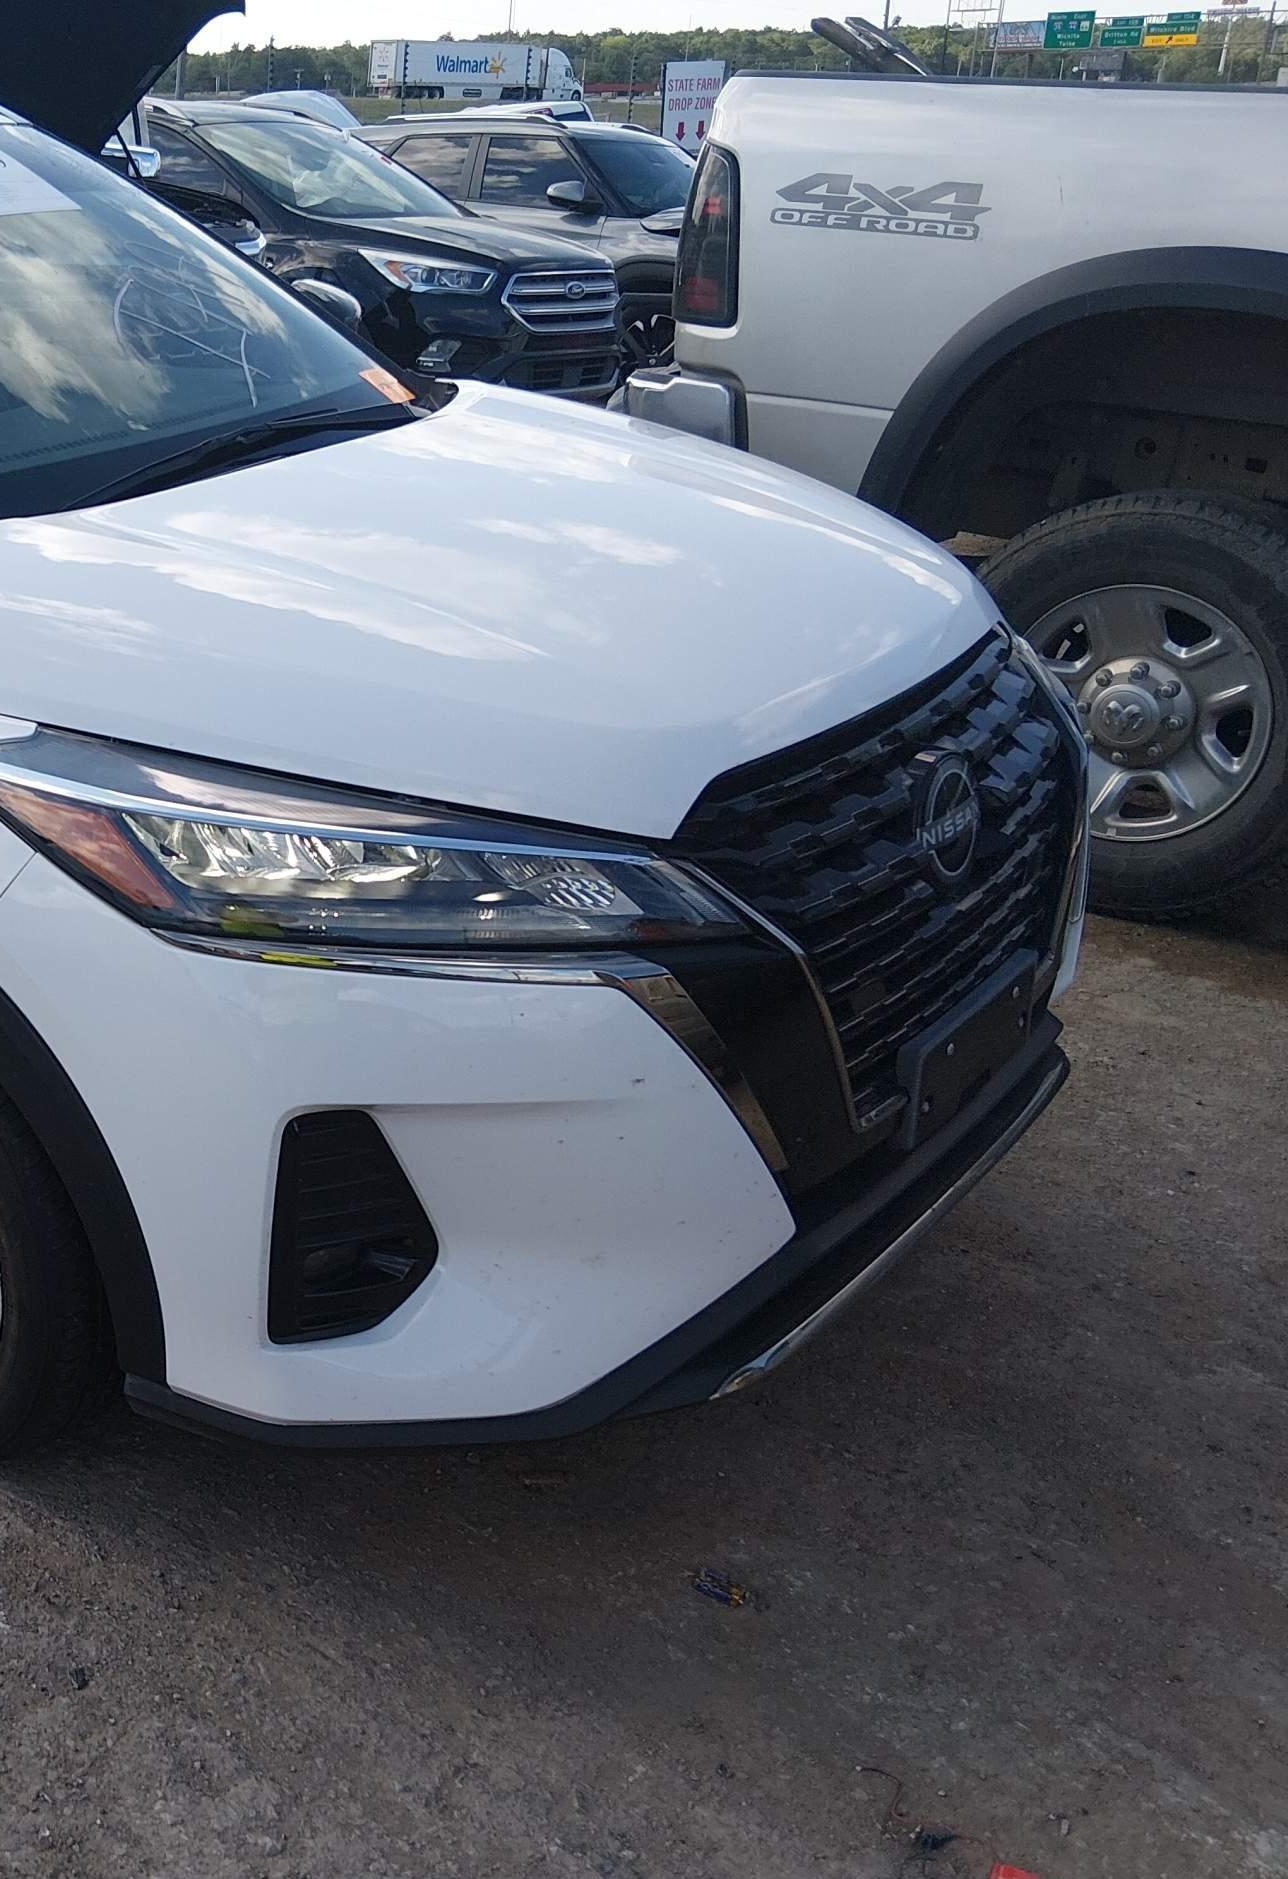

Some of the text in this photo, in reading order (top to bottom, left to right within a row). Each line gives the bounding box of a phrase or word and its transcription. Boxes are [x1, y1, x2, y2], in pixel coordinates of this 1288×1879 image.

[436, 54, 489, 73] Walmart
[668, 77, 721, 92] STATE FARM
[668, 97, 693, 112] DROP
[773, 209, 977, 237] OFF ROAD
